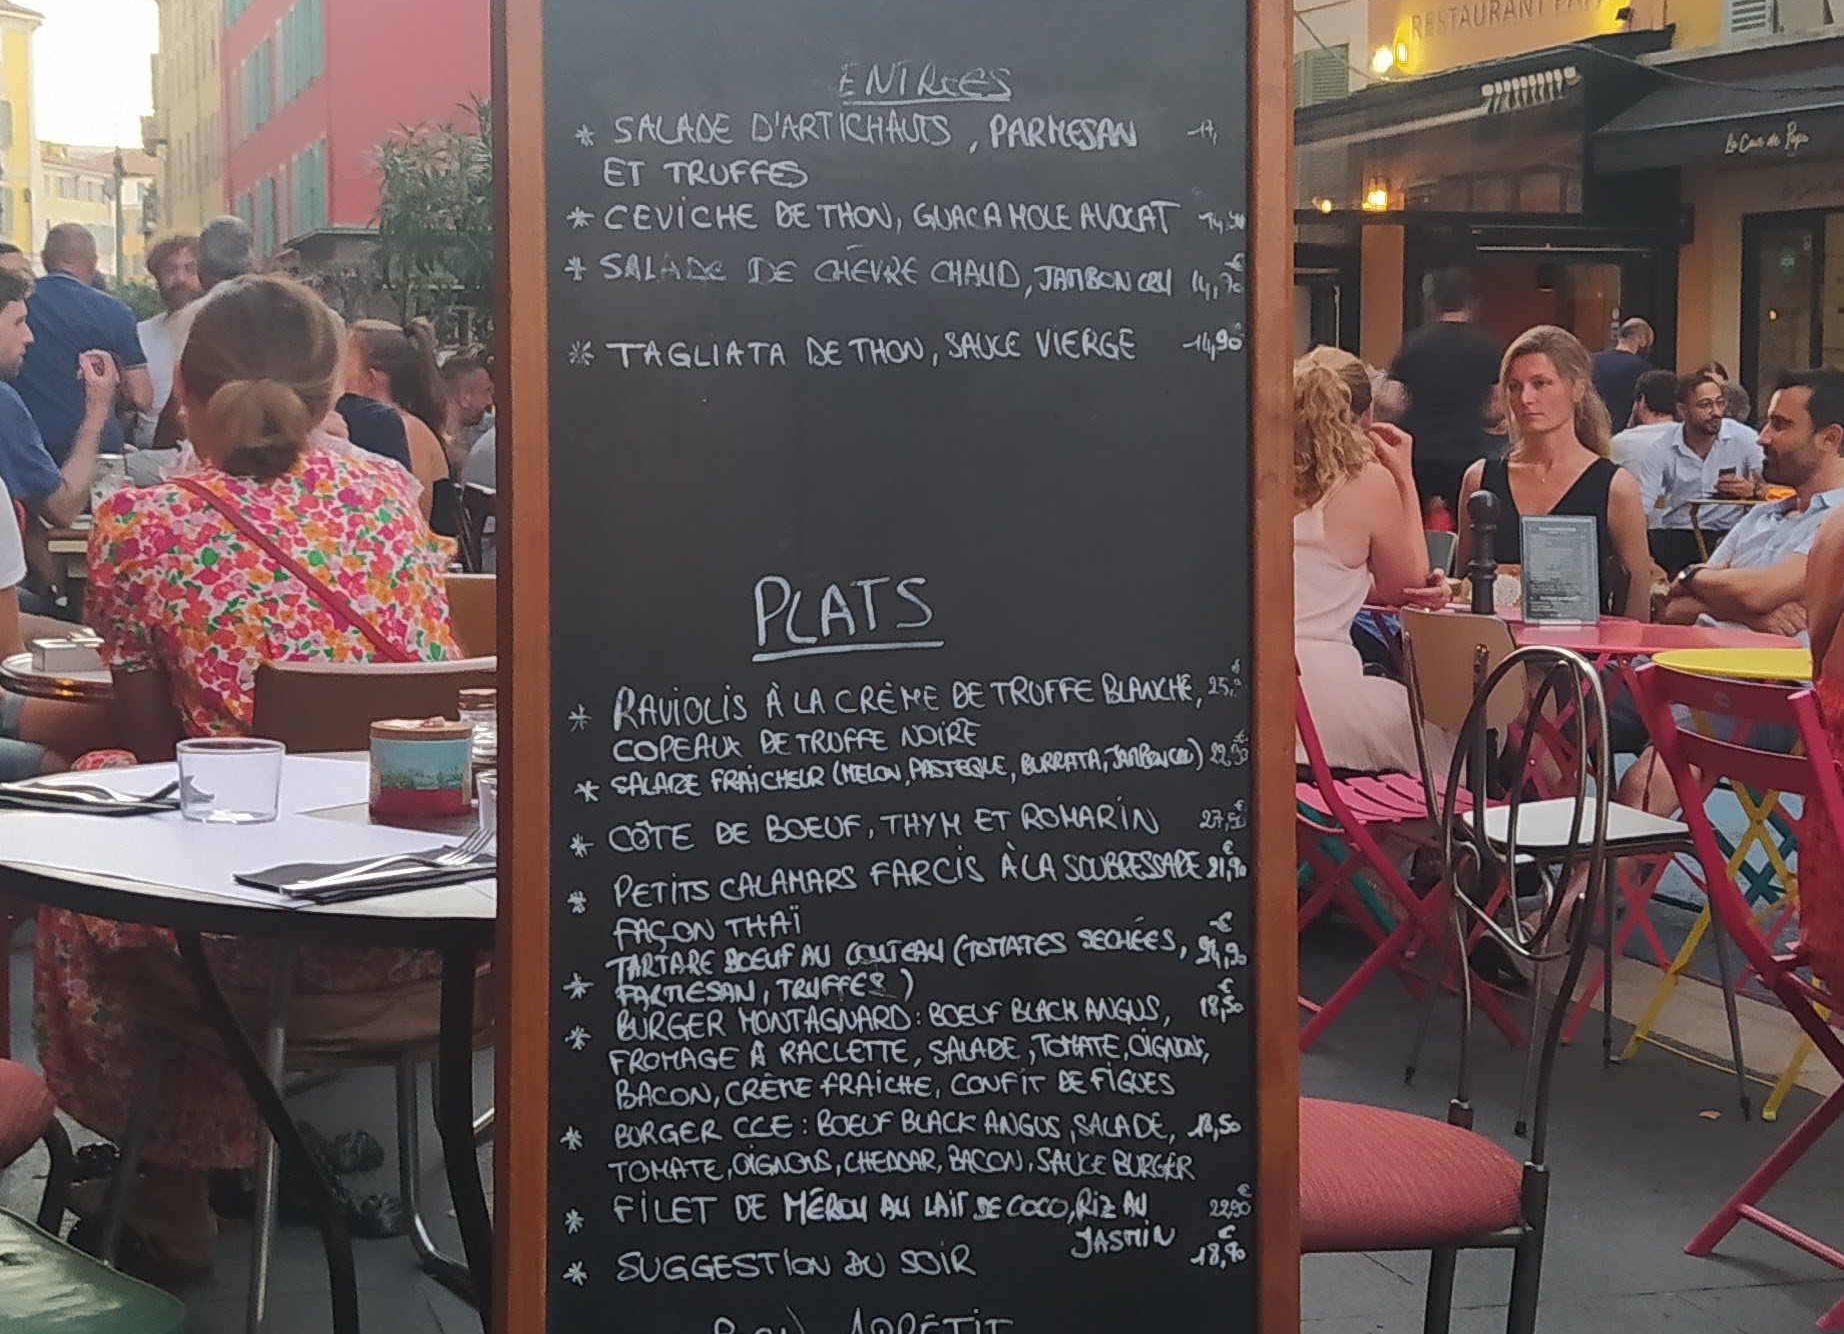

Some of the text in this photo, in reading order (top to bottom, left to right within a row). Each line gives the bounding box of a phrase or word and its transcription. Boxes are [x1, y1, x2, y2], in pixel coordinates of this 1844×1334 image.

[613, 112, 734, 145] SALADE
[989, 113, 1138, 151] PARMESAN
[603, 156, 809, 189] ET TRUFFES
[604, 195, 758, 231] CEVICHE
[775, 200, 812, 230] DE
[1080, 199, 1181, 235] AVOCAT
[600, 252, 727, 282] SALADE
[748, 256, 798, 286] DE
[1033, 264, 1132, 293] JAMBON
[606, 340, 787, 368] TAGLIATA
[806, 336, 843, 366] DE
[945, 330, 1021, 361] SAUCE
[1036, 327, 1136, 361] VIERGE
[754, 575, 934, 647] PLATS
[612, 683, 748, 732] RAVIOLIS
[766, 681, 785, 719] À
[794, 686, 826, 715] LA
[953, 680, 985, 709] DE
[990, 675, 1095, 707] TRUFFE
[612, 717, 982, 763] COPEAUX DE TRUFFE NOIRE
[608, 819, 696, 853] CÔTE
[715, 822, 751, 846] DE
[880, 810, 963, 839] THYM
[974, 808, 1012, 833] ET
[1021, 796, 1160, 835] ROMARIN
[613, 871, 711, 909] PETITS
[719, 865, 858, 902] CALAMARS
[870, 845, 986, 889] FARCIS
[1001, 841, 1018, 880] À
[1021, 853, 1058, 883] LA
[613, 904, 801, 953] FAÇON THAÏ
[604, 949, 716, 986] TARTARE
[724, 942, 796, 974] BOEUF
[801, 942, 831, 968] AU
[616, 1008, 728, 1042] BURGER
[929, 1001, 1003, 1028] BOEUF
[1011, 997, 1080, 1023] BLACK
[608, 1046, 740, 1076] FROMAGE
[951, 1067, 1047, 1097] CONFIT
[1058, 1070, 1088, 1095] DE
[1089, 1061, 1176, 1097] FIGUES
[614, 1119, 724, 1150] BURGER
[816, 1108, 895, 1138] BOEUF
[901, 1108, 977, 1135] BLACK
[1036, 1146, 1107, 1178] SAUCE
[1111, 1147, 1196, 1182] BURGER
[612, 1188, 719, 1225] FILET
[734, 1193, 768, 1223] DE
[880, 1191, 911, 1222] AU
[924, 1189, 970, 1219] LAIT
[972, 1195, 1002, 1221] DE
[1123, 1189, 1149, 1218] AU
[1070, 1218, 1177, 1260] JASMIN
[615, 1246, 832, 1284] SUGGESTION
[844, 1249, 887, 1279] DU
[900, 1239, 977, 1277] SOIR
